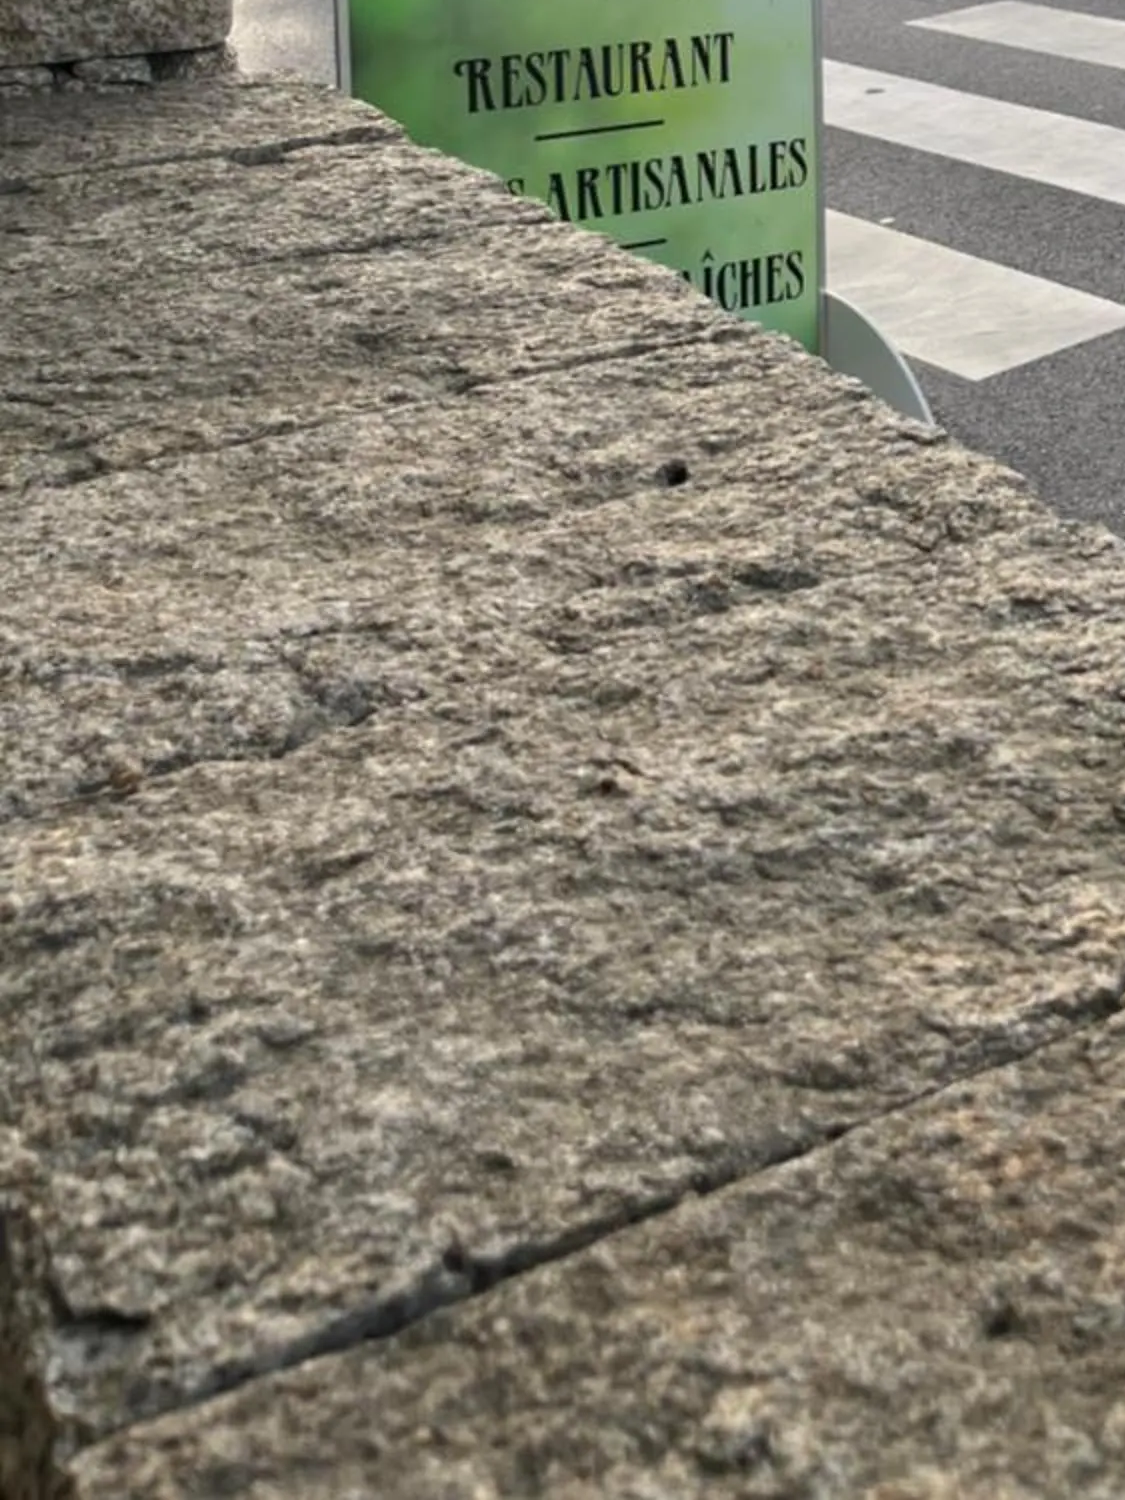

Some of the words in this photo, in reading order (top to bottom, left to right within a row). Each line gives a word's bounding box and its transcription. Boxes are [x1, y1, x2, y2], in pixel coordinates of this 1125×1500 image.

[453, 32, 736, 114] RESTAURANT
[548, 137, 808, 222] ARTISANALES
[682, 248, 805, 313] ÎCHES
